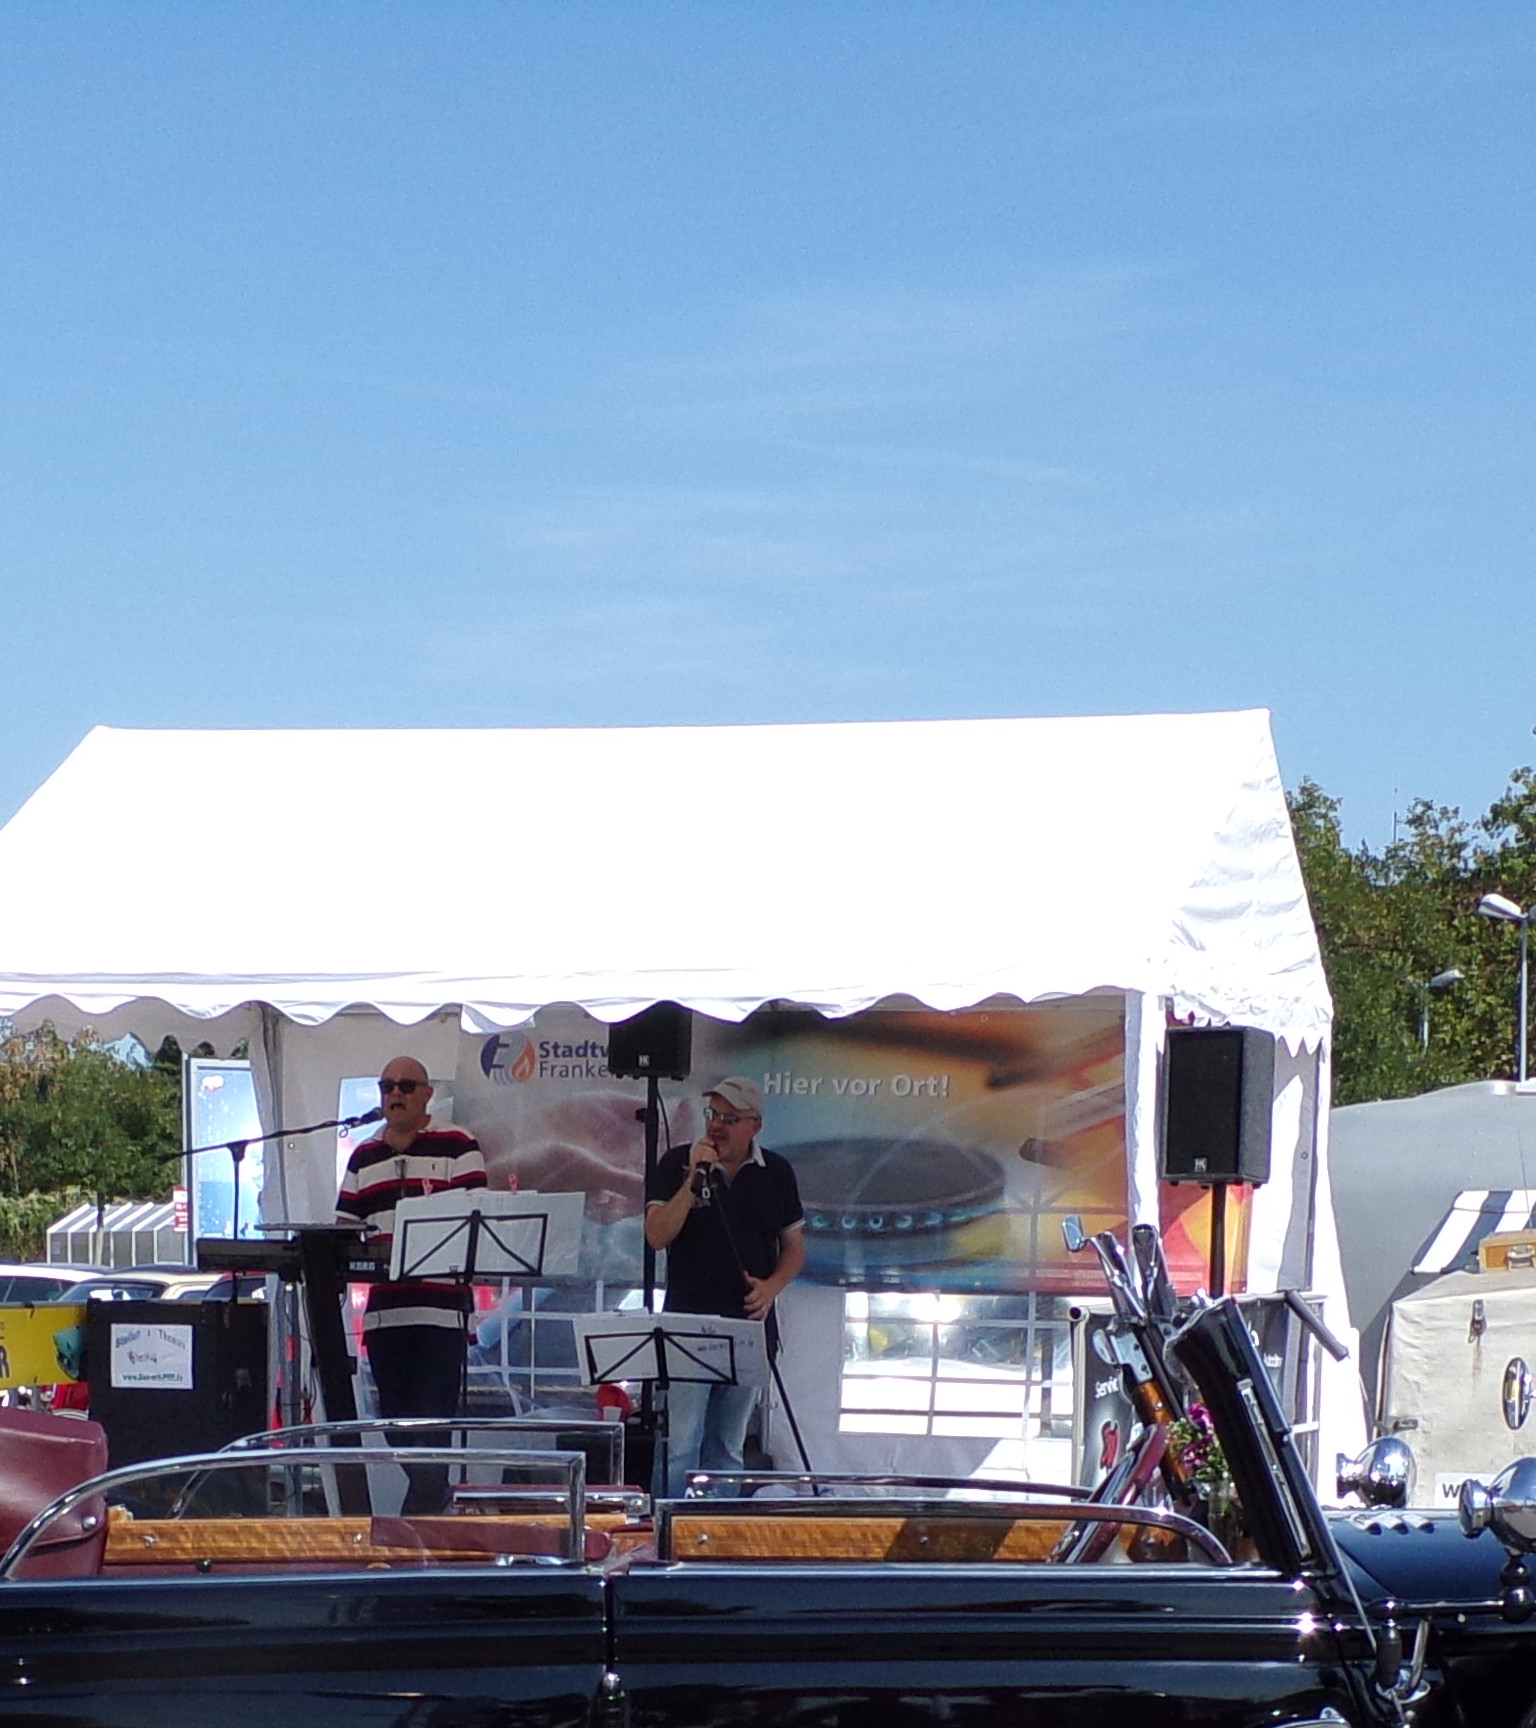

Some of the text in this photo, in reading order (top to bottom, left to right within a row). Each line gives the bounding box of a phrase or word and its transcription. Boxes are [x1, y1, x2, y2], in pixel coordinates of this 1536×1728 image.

[538, 1060, 611, 1078] Franke
[763, 1071, 951, 1098] Hier vor Ort!
